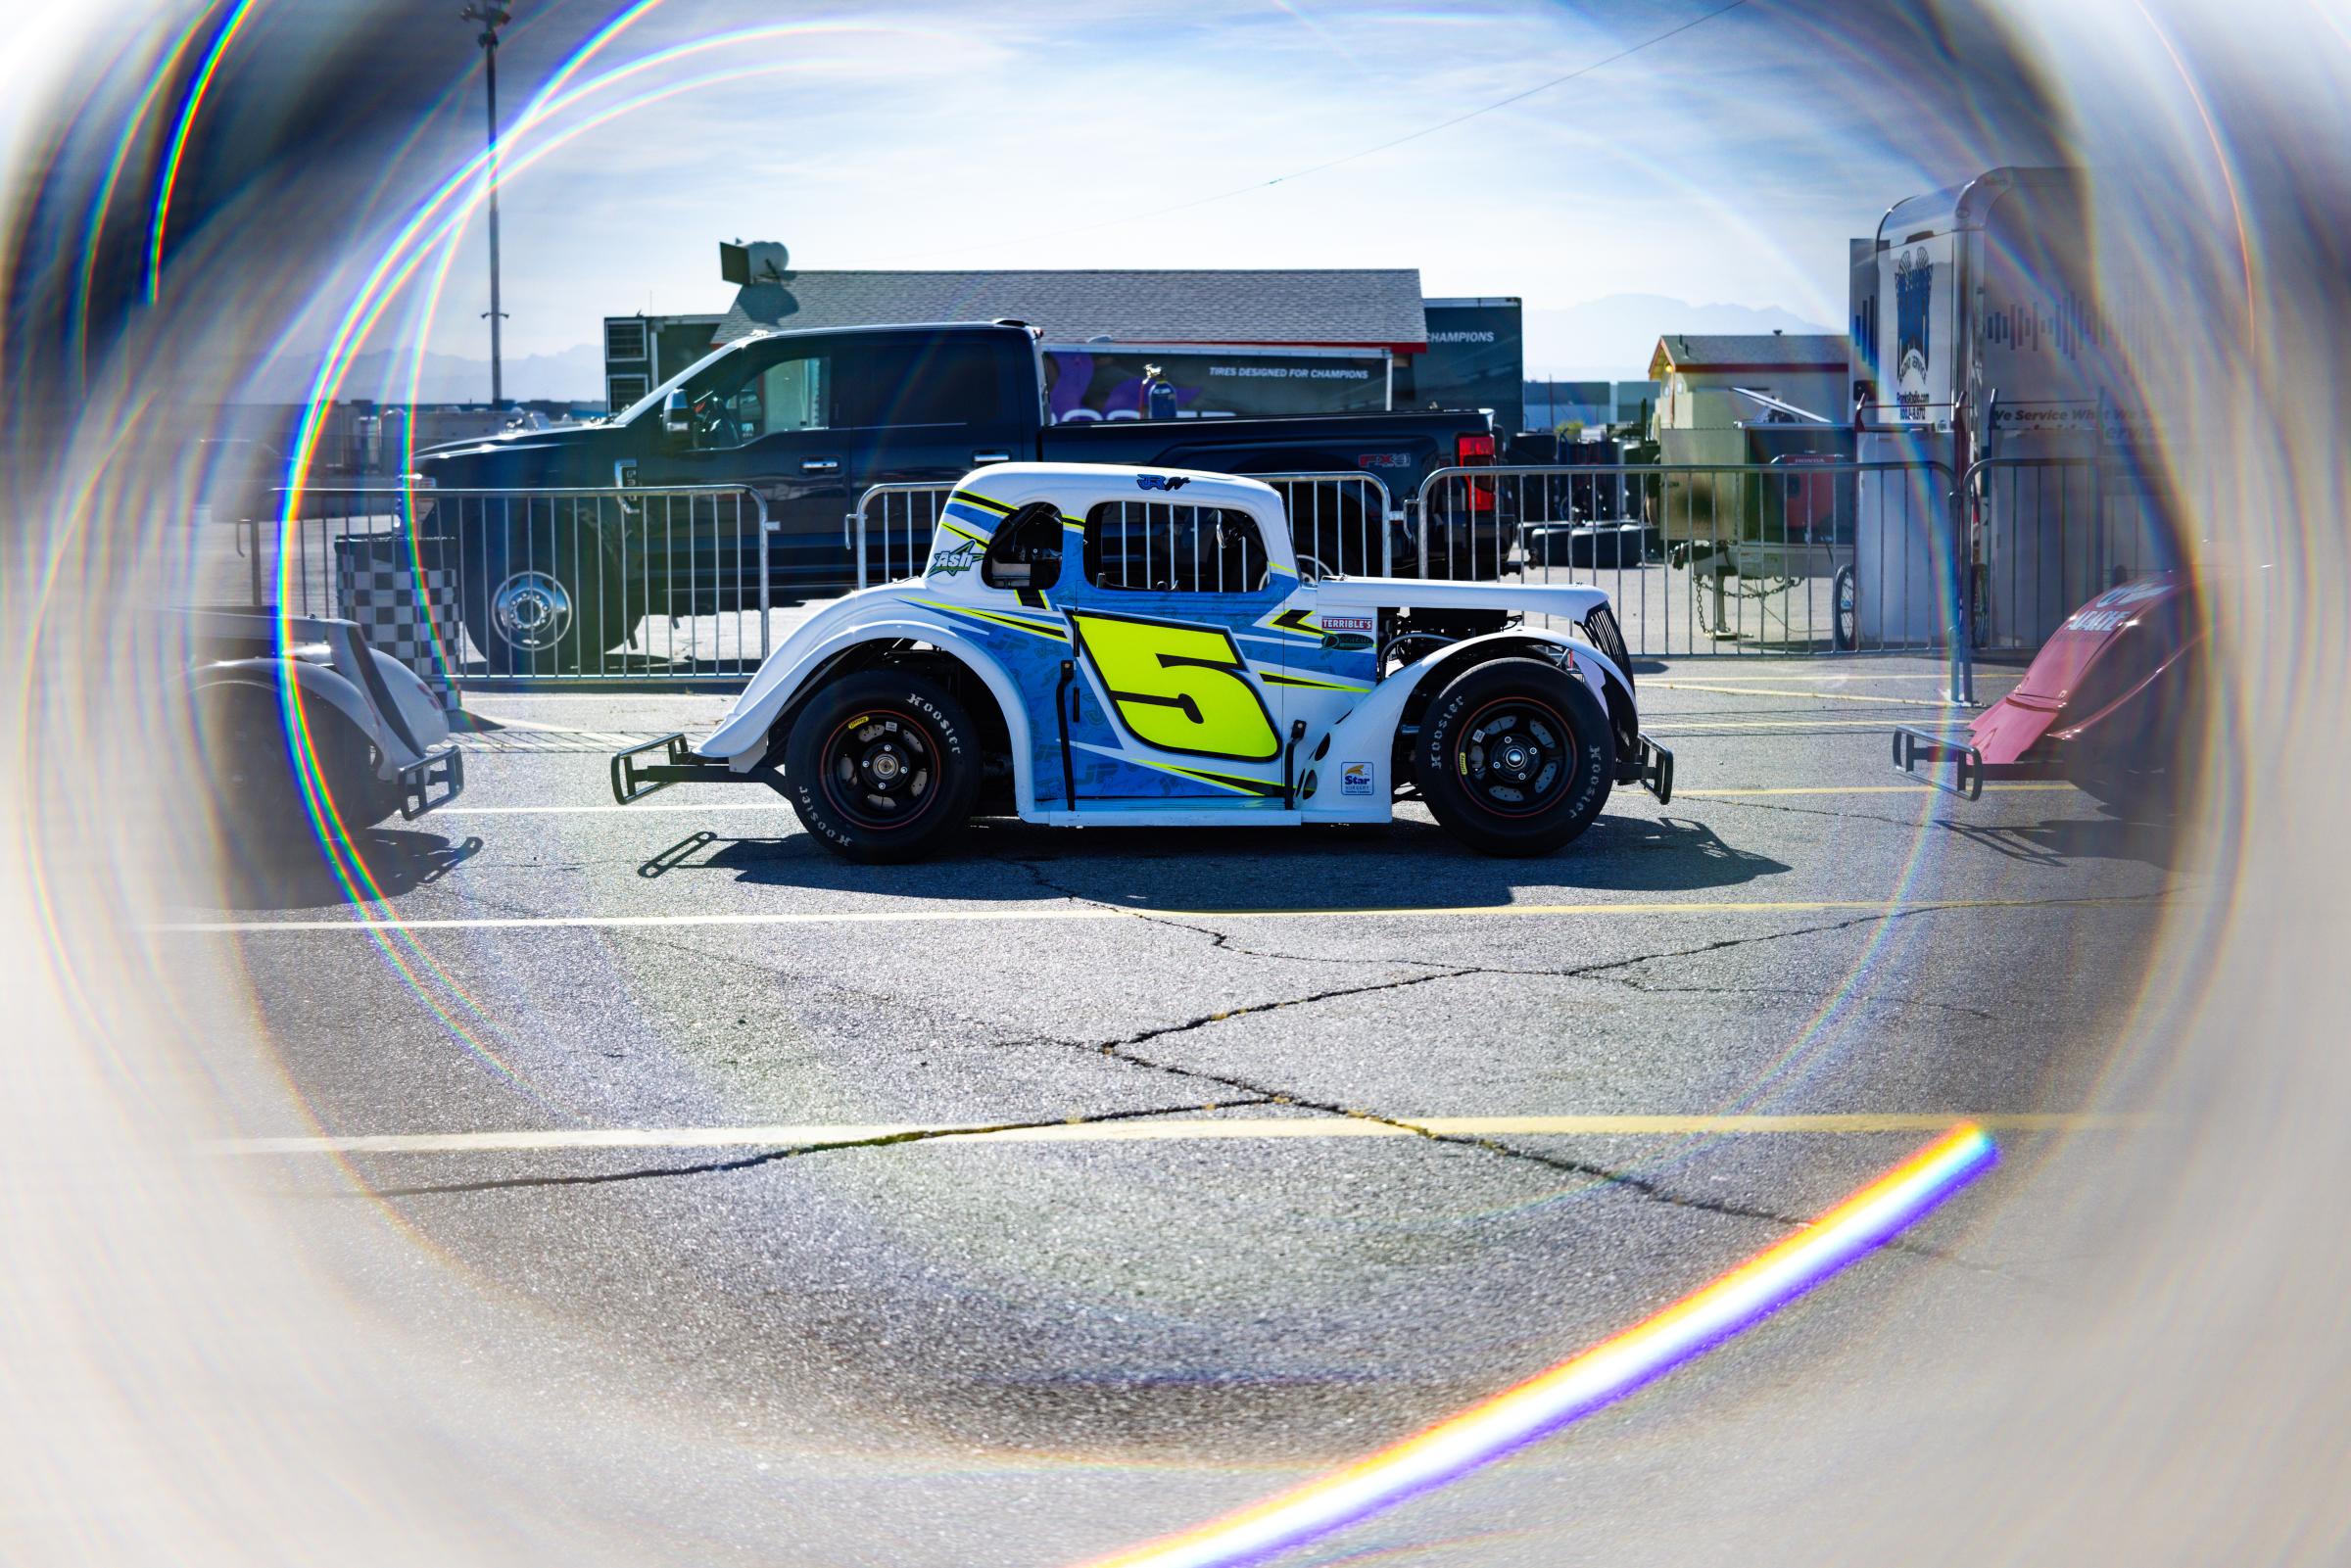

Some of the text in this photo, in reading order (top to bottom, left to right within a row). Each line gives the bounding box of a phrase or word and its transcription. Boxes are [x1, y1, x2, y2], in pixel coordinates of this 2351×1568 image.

[1209, 366, 1368, 379] TIRES DESIGNED FOR CHAMPIONS
[2015, 409, 2068, 421] Service
[2072, 407, 2109, 420] Wht
[935, 551, 973, 567] Ash
[1322, 619, 1371, 629] TERRIBLE'S
[1064, 607, 1283, 764] 5
[907, 693, 961, 755] Hoosier
[1431, 695, 1464, 770] Hoosier
[1344, 775, 1370, 785] Star
[1569, 744, 1602, 818] Hoosier
[799, 785, 852, 847] Hoosier
